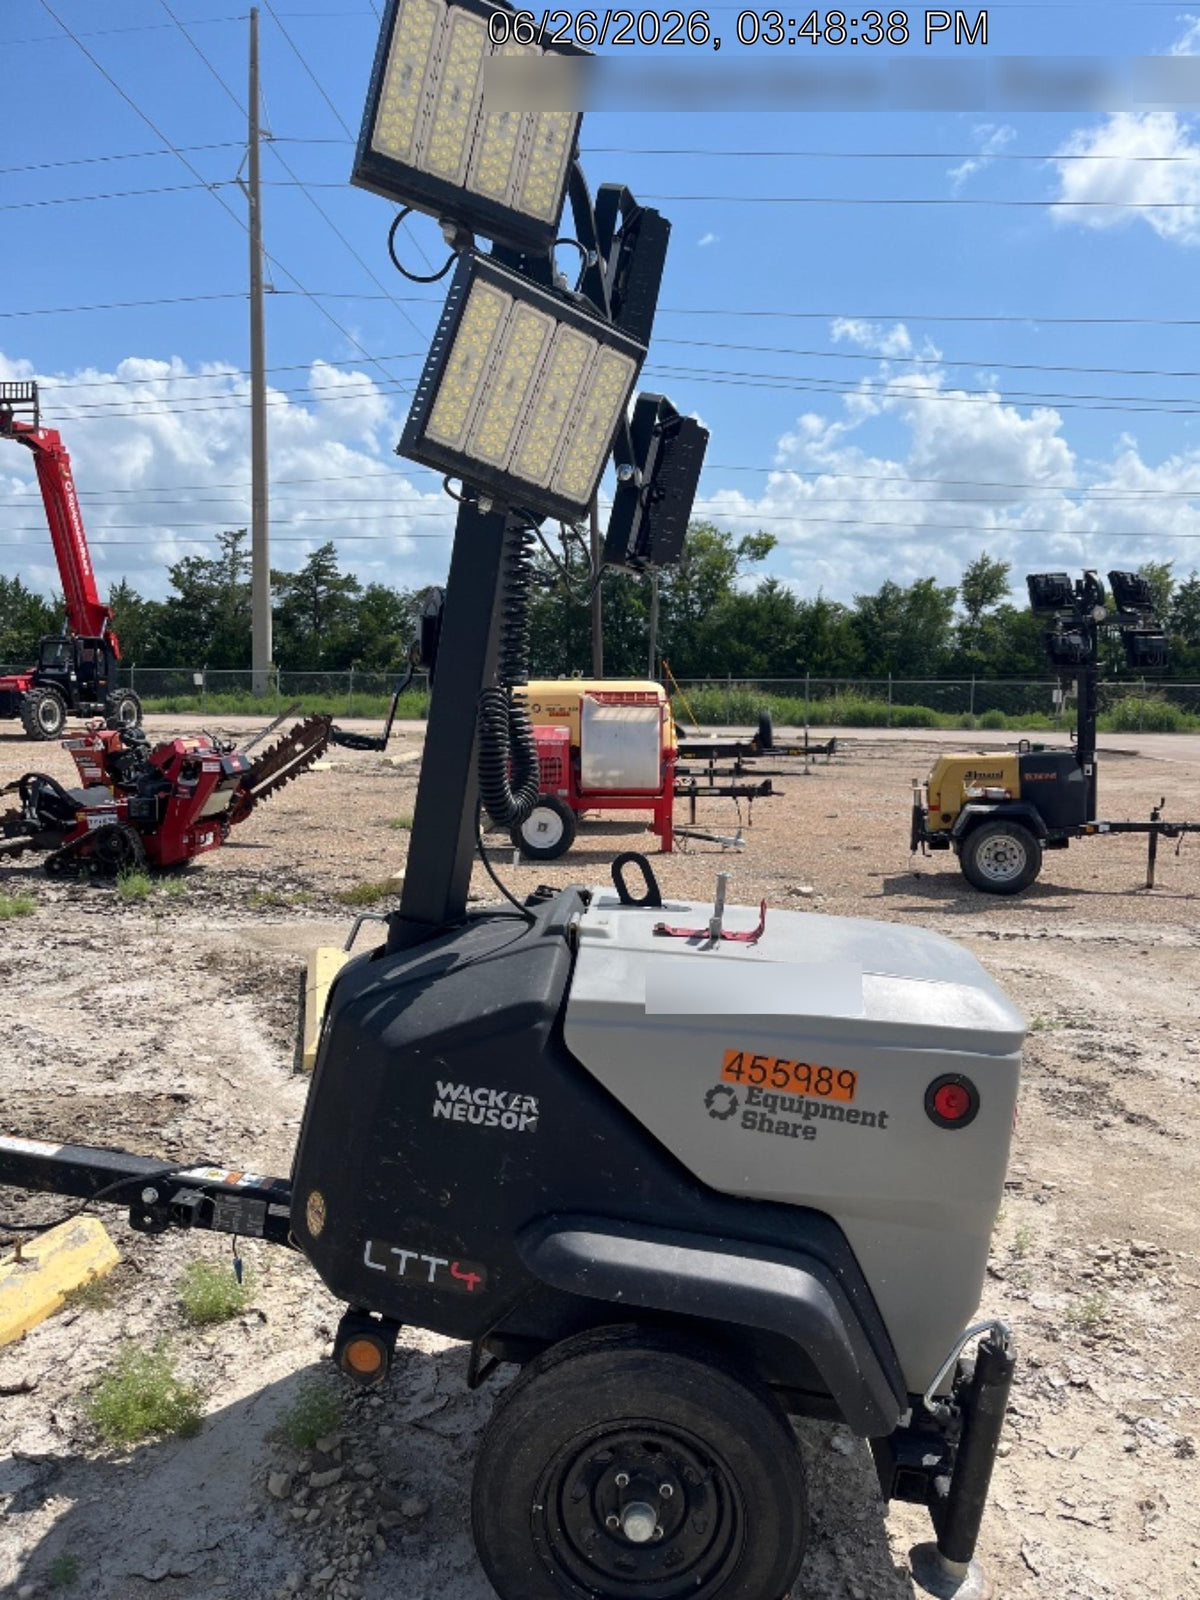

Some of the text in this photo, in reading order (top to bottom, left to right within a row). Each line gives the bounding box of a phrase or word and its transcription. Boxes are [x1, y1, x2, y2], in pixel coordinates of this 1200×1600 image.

[725, 1052, 855, 1098] 455989
[740, 1110, 818, 1141] Share
[744, 1086, 889, 1130] Equipment
[363, 1240, 483, 1292] LTT4
